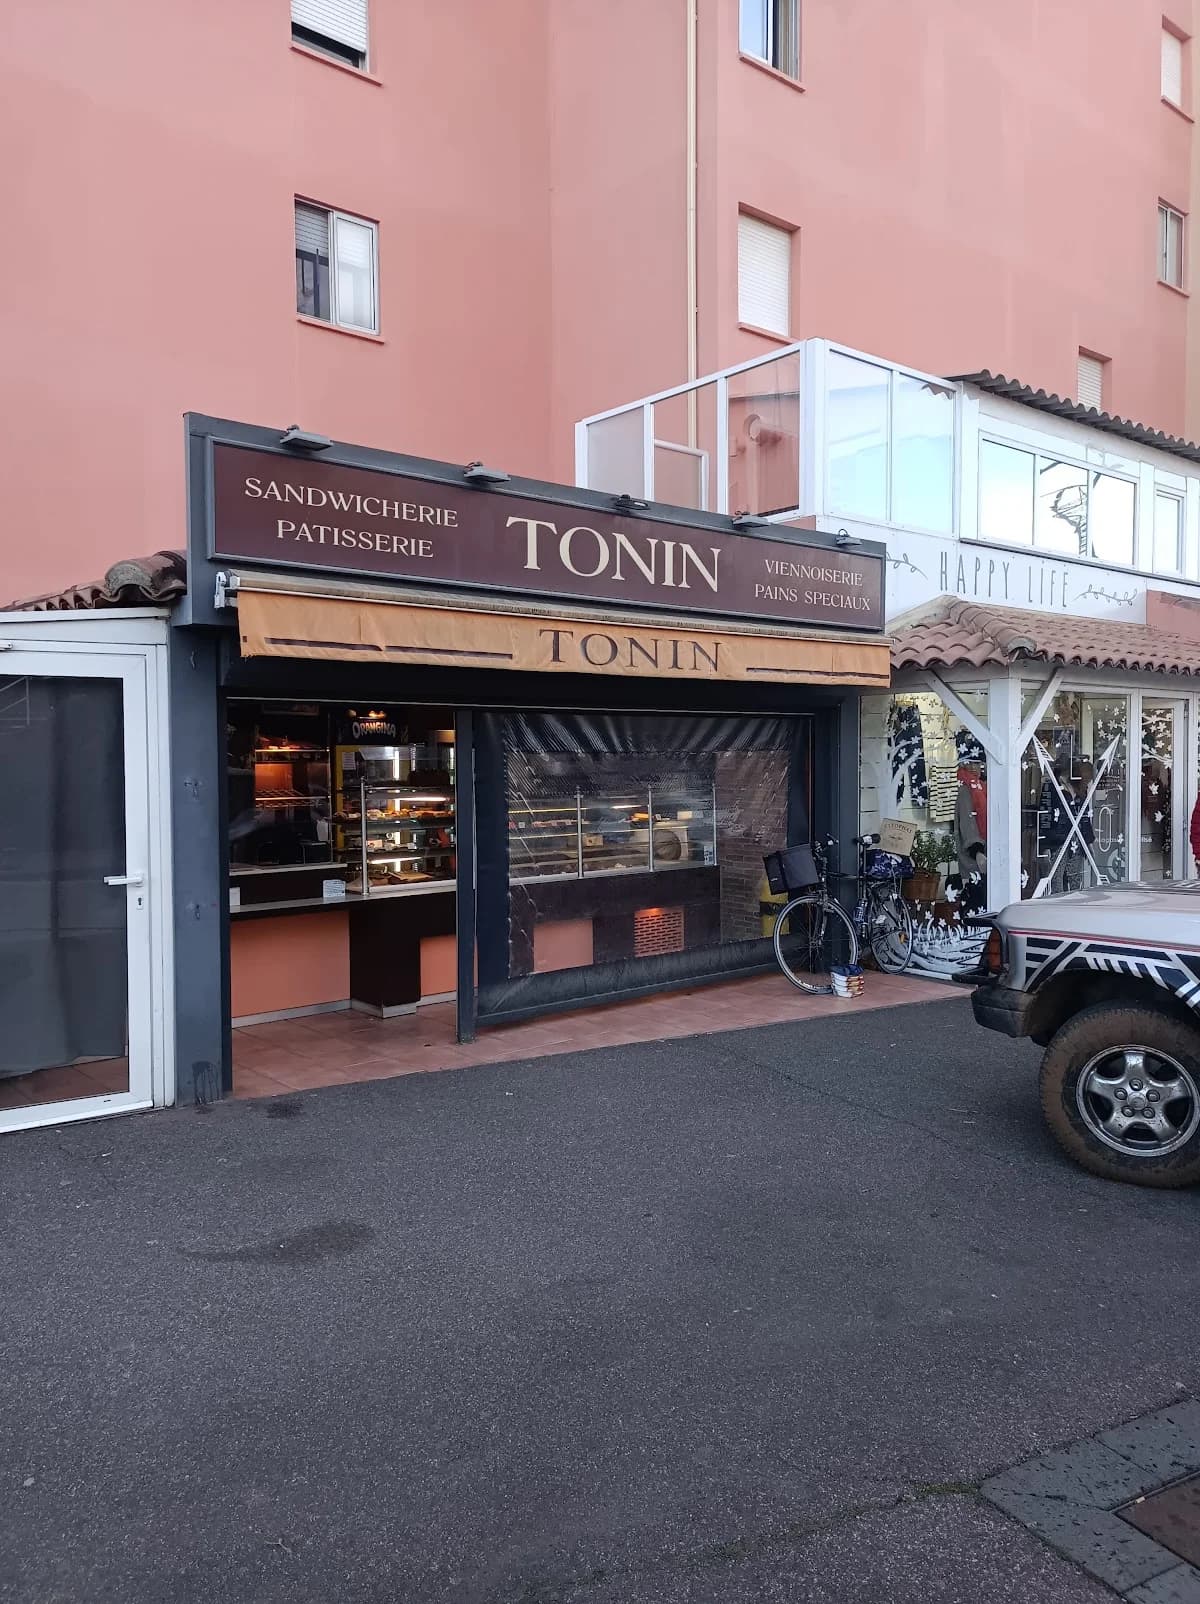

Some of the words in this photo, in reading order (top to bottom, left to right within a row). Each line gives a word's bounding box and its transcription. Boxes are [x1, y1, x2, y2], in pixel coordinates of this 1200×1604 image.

[244, 477, 459, 528] SANDWICHERIE
[276, 519, 434, 558] PATISSERIE
[505, 515, 722, 593] TONIN
[764, 558, 864, 588] VIENNOISERIE
[940, 551, 1010, 600] HAPPY
[1028, 564, 1069, 608] LIFE
[754, 583, 798, 603] PAINS
[803, 588, 871, 612] SPECIAUX
[538, 628, 723, 673] TONIN
[352, 720, 396, 738] ORANGINA
